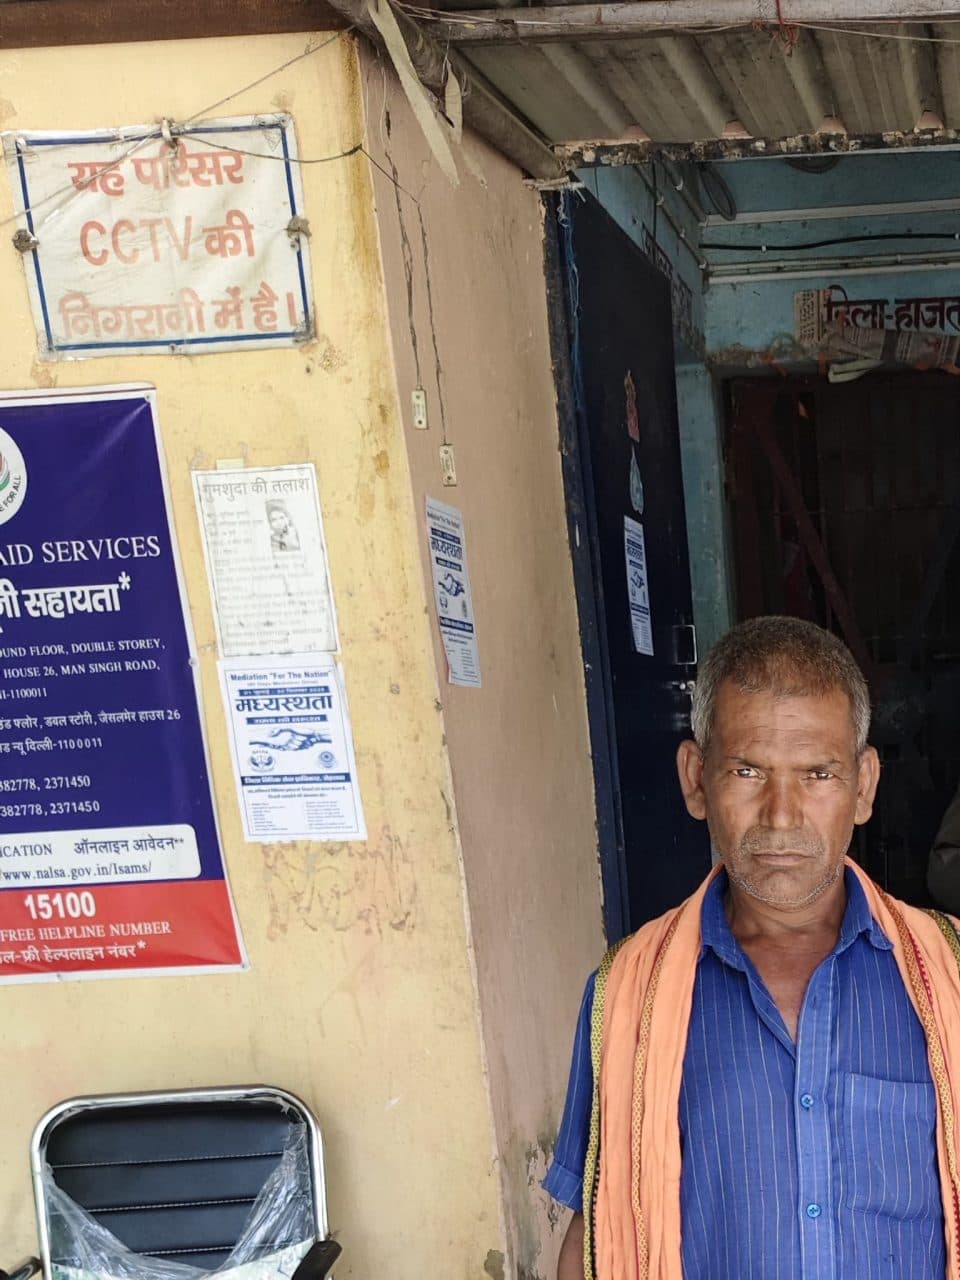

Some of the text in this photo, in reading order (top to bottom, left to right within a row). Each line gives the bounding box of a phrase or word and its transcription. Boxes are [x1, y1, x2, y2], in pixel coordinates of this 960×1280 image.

[67, 140, 245, 197] यह परिसर
[80, 209, 255, 266] CCTV की
[58, 288, 206, 338] निगरानी
[212, 286, 244, 330] में
[251, 477, 269, 495] की
[273, 475, 311, 495] तलाश
[42, 536, 161, 564] SERVICES
[30, 644, 69, 656] FLOOR,
[71, 641, 116, 654] DOUBLE
[118, 638, 165, 651] STOREY,
[3, 659, 160, 679] HOUSE 26, MAN SINGH ROAD,
[231, 672, 268, 681] Mediation
[287, 671, 302, 680] The
[234, 695, 333, 712] मध्यस्थता
[167, 709, 181, 720] 26
[44, 775, 91, 790] 2371450
[50, 801, 100, 814] 2371450
[74, 837, 129, 855] ऑनलाइन
[24, 891, 96, 919] 15100
[0, 921, 172, 942] FREE HELPLINE NUMBER
